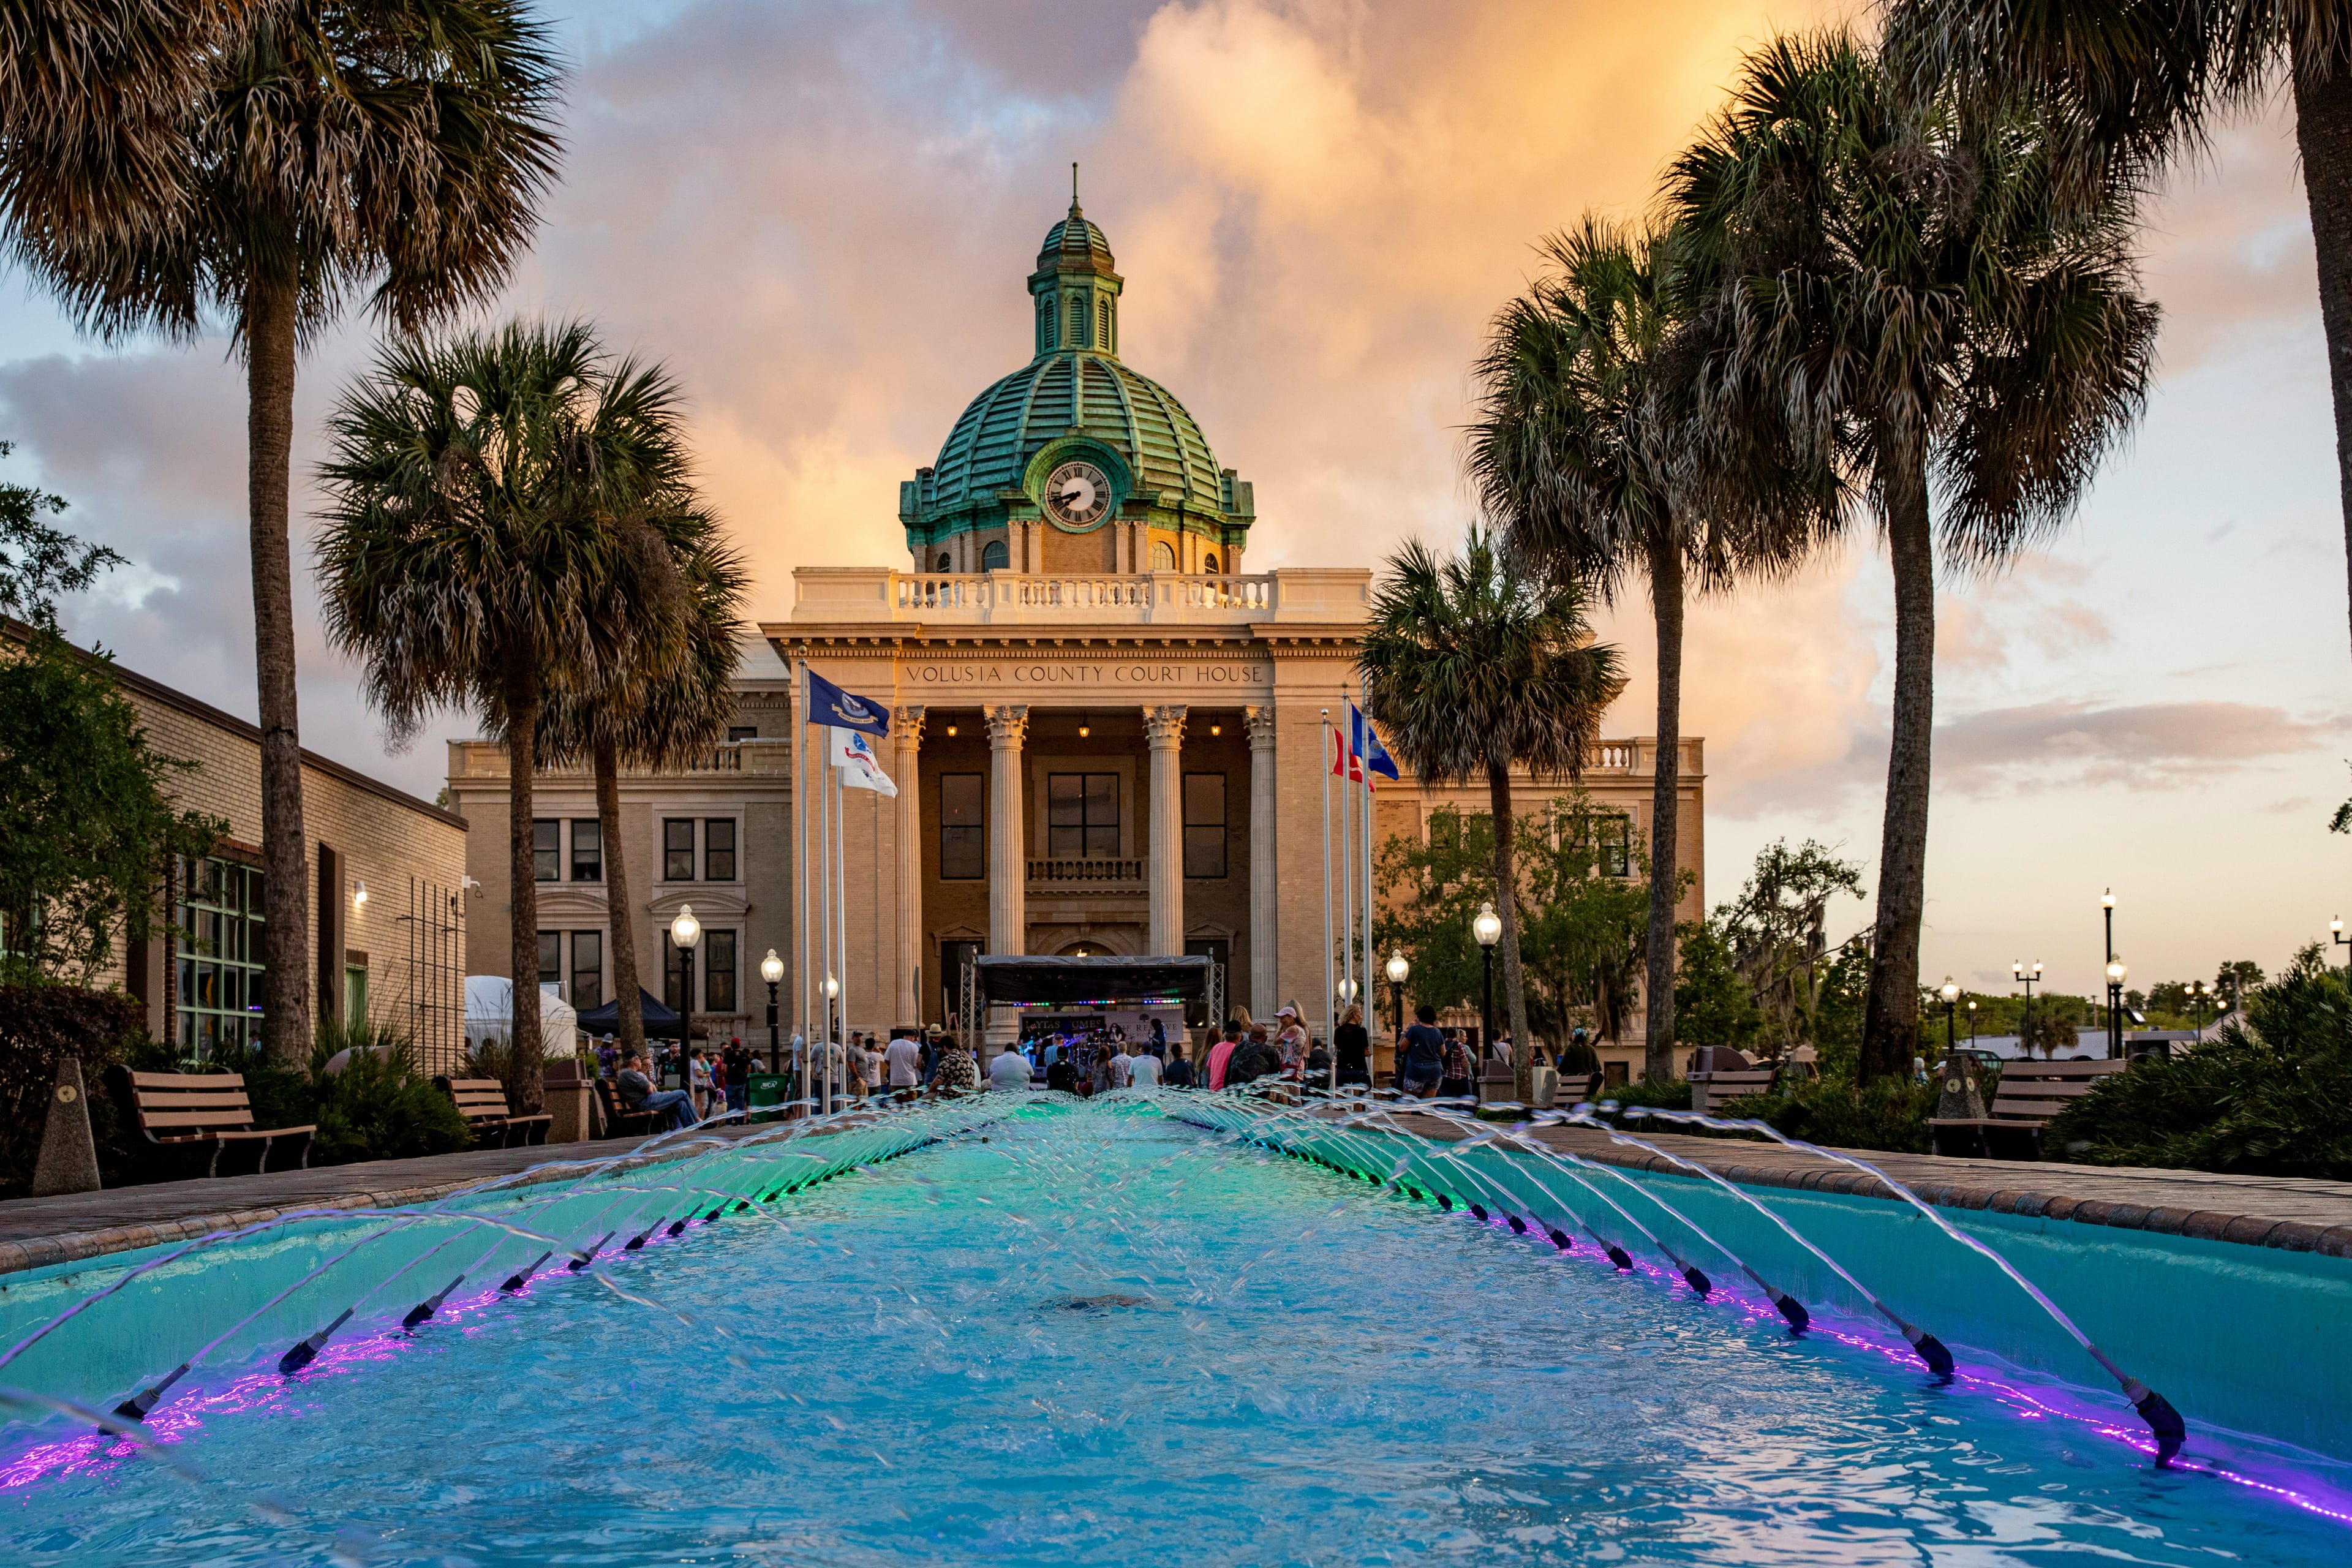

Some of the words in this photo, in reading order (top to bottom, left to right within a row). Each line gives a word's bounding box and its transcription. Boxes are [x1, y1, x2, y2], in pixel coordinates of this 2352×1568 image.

[907, 666, 1001, 682] VOLUSIA
[1014, 666, 1103, 682] COUNTY
[1115, 666, 1186, 682] COURT
[1197, 666, 1262, 682] HOUSE
